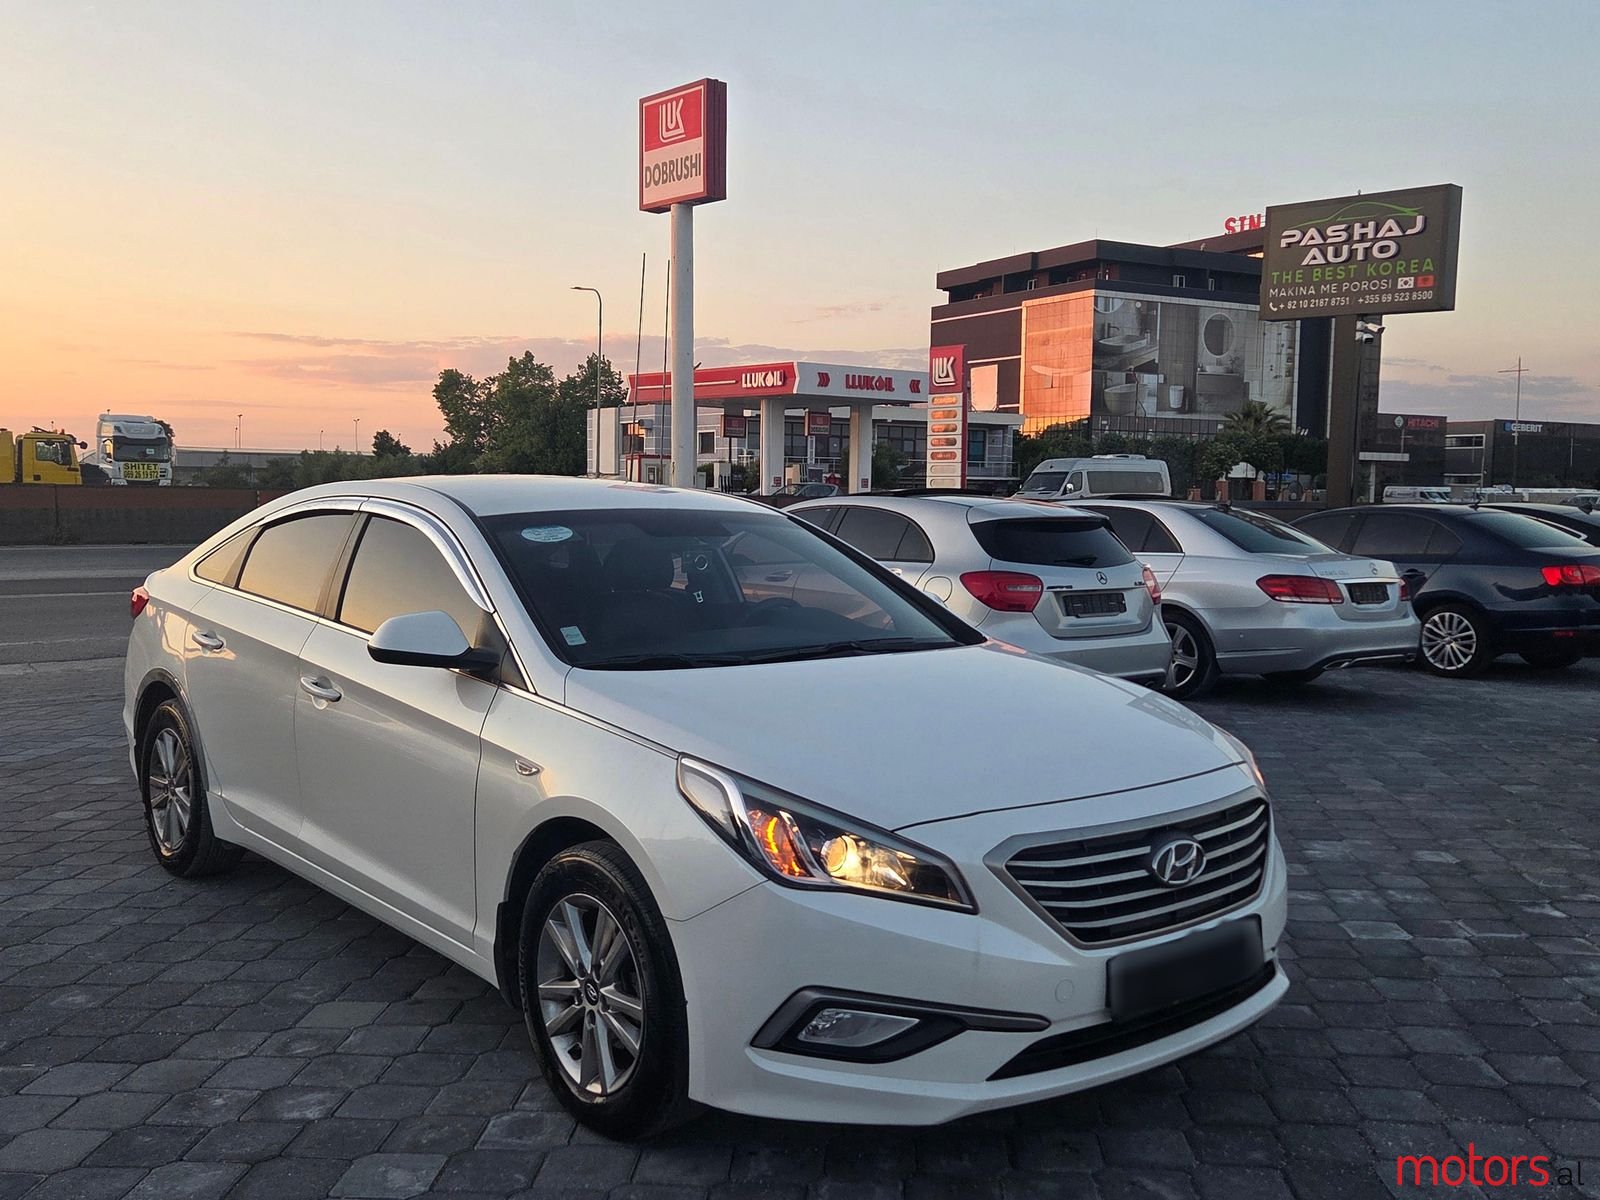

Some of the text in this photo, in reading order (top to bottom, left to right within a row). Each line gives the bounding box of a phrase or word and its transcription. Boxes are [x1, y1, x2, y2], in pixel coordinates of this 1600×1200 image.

[645, 152, 701, 188] DOBRUSHI
[1280, 215, 1426, 248] PASHAJ
[1301, 240, 1399, 266] AUTO
[1271, 258, 1435, 285] THE BEST KOREA
[1269, 279, 1392, 298] MAKINA ME POROSI
[1299, 299, 1309, 309] 10
[1407, 418, 1440, 428] HITACHI
[1511, 423, 1543, 433] GEBERIT
